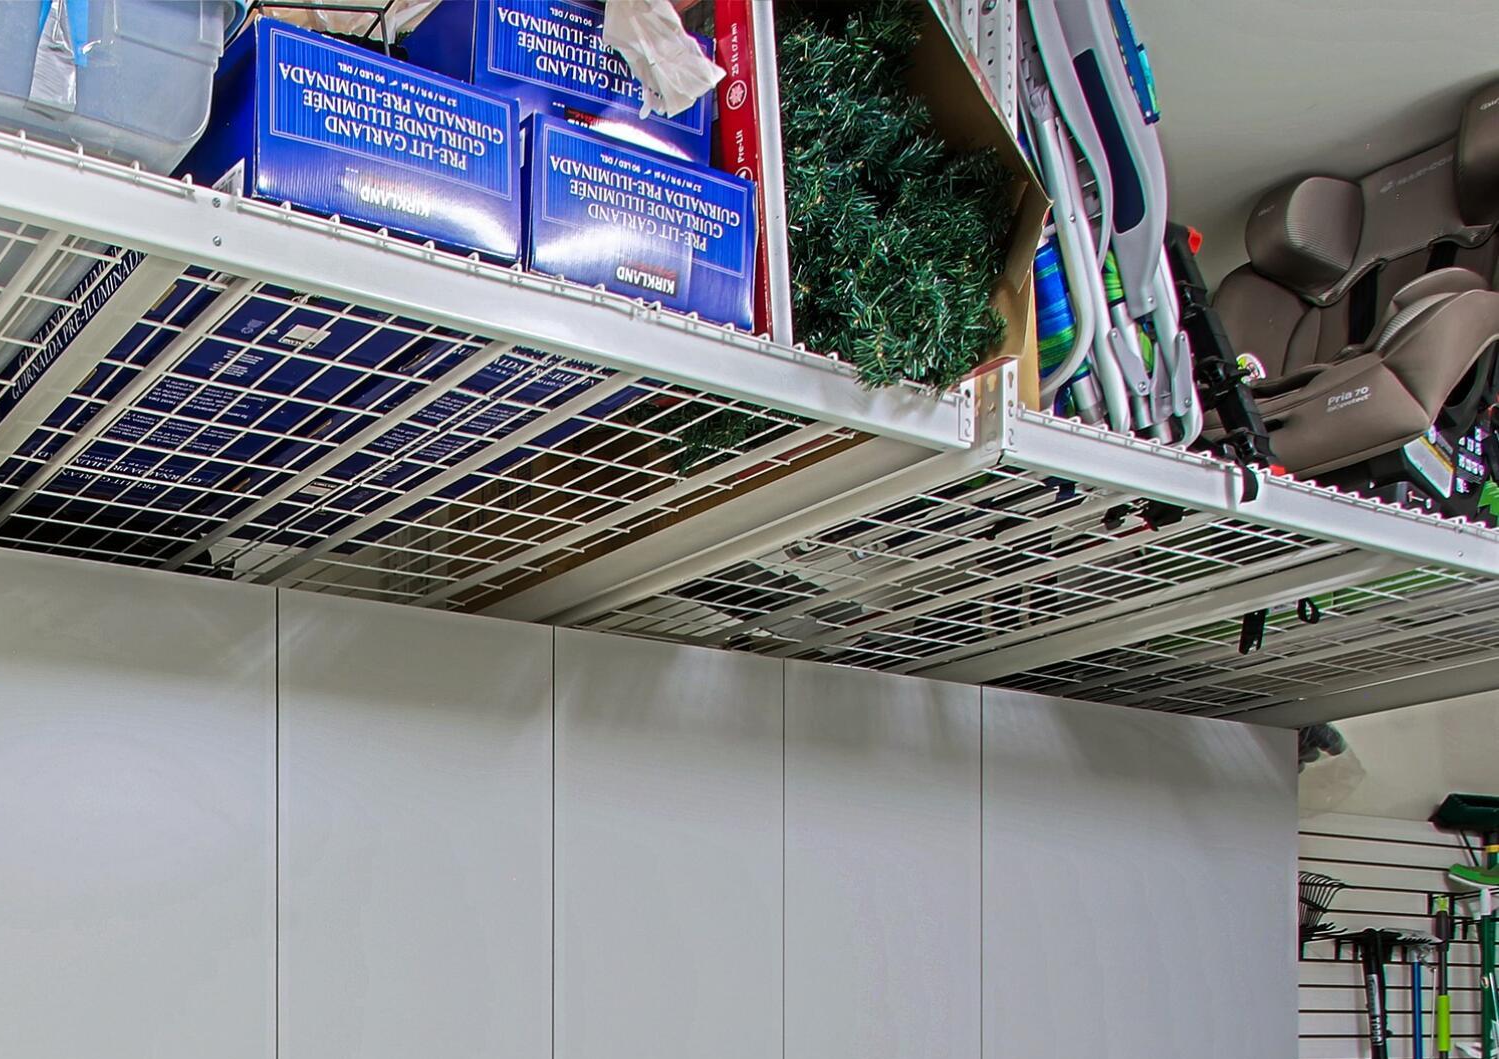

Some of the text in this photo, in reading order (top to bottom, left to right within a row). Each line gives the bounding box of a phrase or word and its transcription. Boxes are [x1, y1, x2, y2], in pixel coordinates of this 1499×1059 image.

[549, 7, 564, 17] DEL
[569, 14, 583, 24] LED
[517, 31, 596, 67] ILLUMINÉE
[337, 62, 353, 74] DEL
[359, 71, 375, 82] LED
[535, 55, 609, 89] GARLAND
[278, 62, 504, 145] GUIRNALDA PRE-ILUMINADA
[611, 83, 644, 100] E-LIT
[302, 89, 485, 157] GUIRLANDE ILLUMINÉE
[325, 116, 467, 171] PRE-LIT GARLAND
[600, 154, 613, 165] DEL
[619, 162, 631, 171] LED
[359, 185, 431, 217] KIRKLAND
[550, 155, 740, 226] GUIRNALDA PRE-ILUMINADA
[569, 179, 723, 238] GUIRLANDE ILLUMINÉE
[588, 203, 707, 252] PRE-LIT GARLAND
[616, 266, 675, 294] KIRKLAND
[11, 339, 64, 400] GUIRNALDA
[1355, 386, 1370, 397] 70
